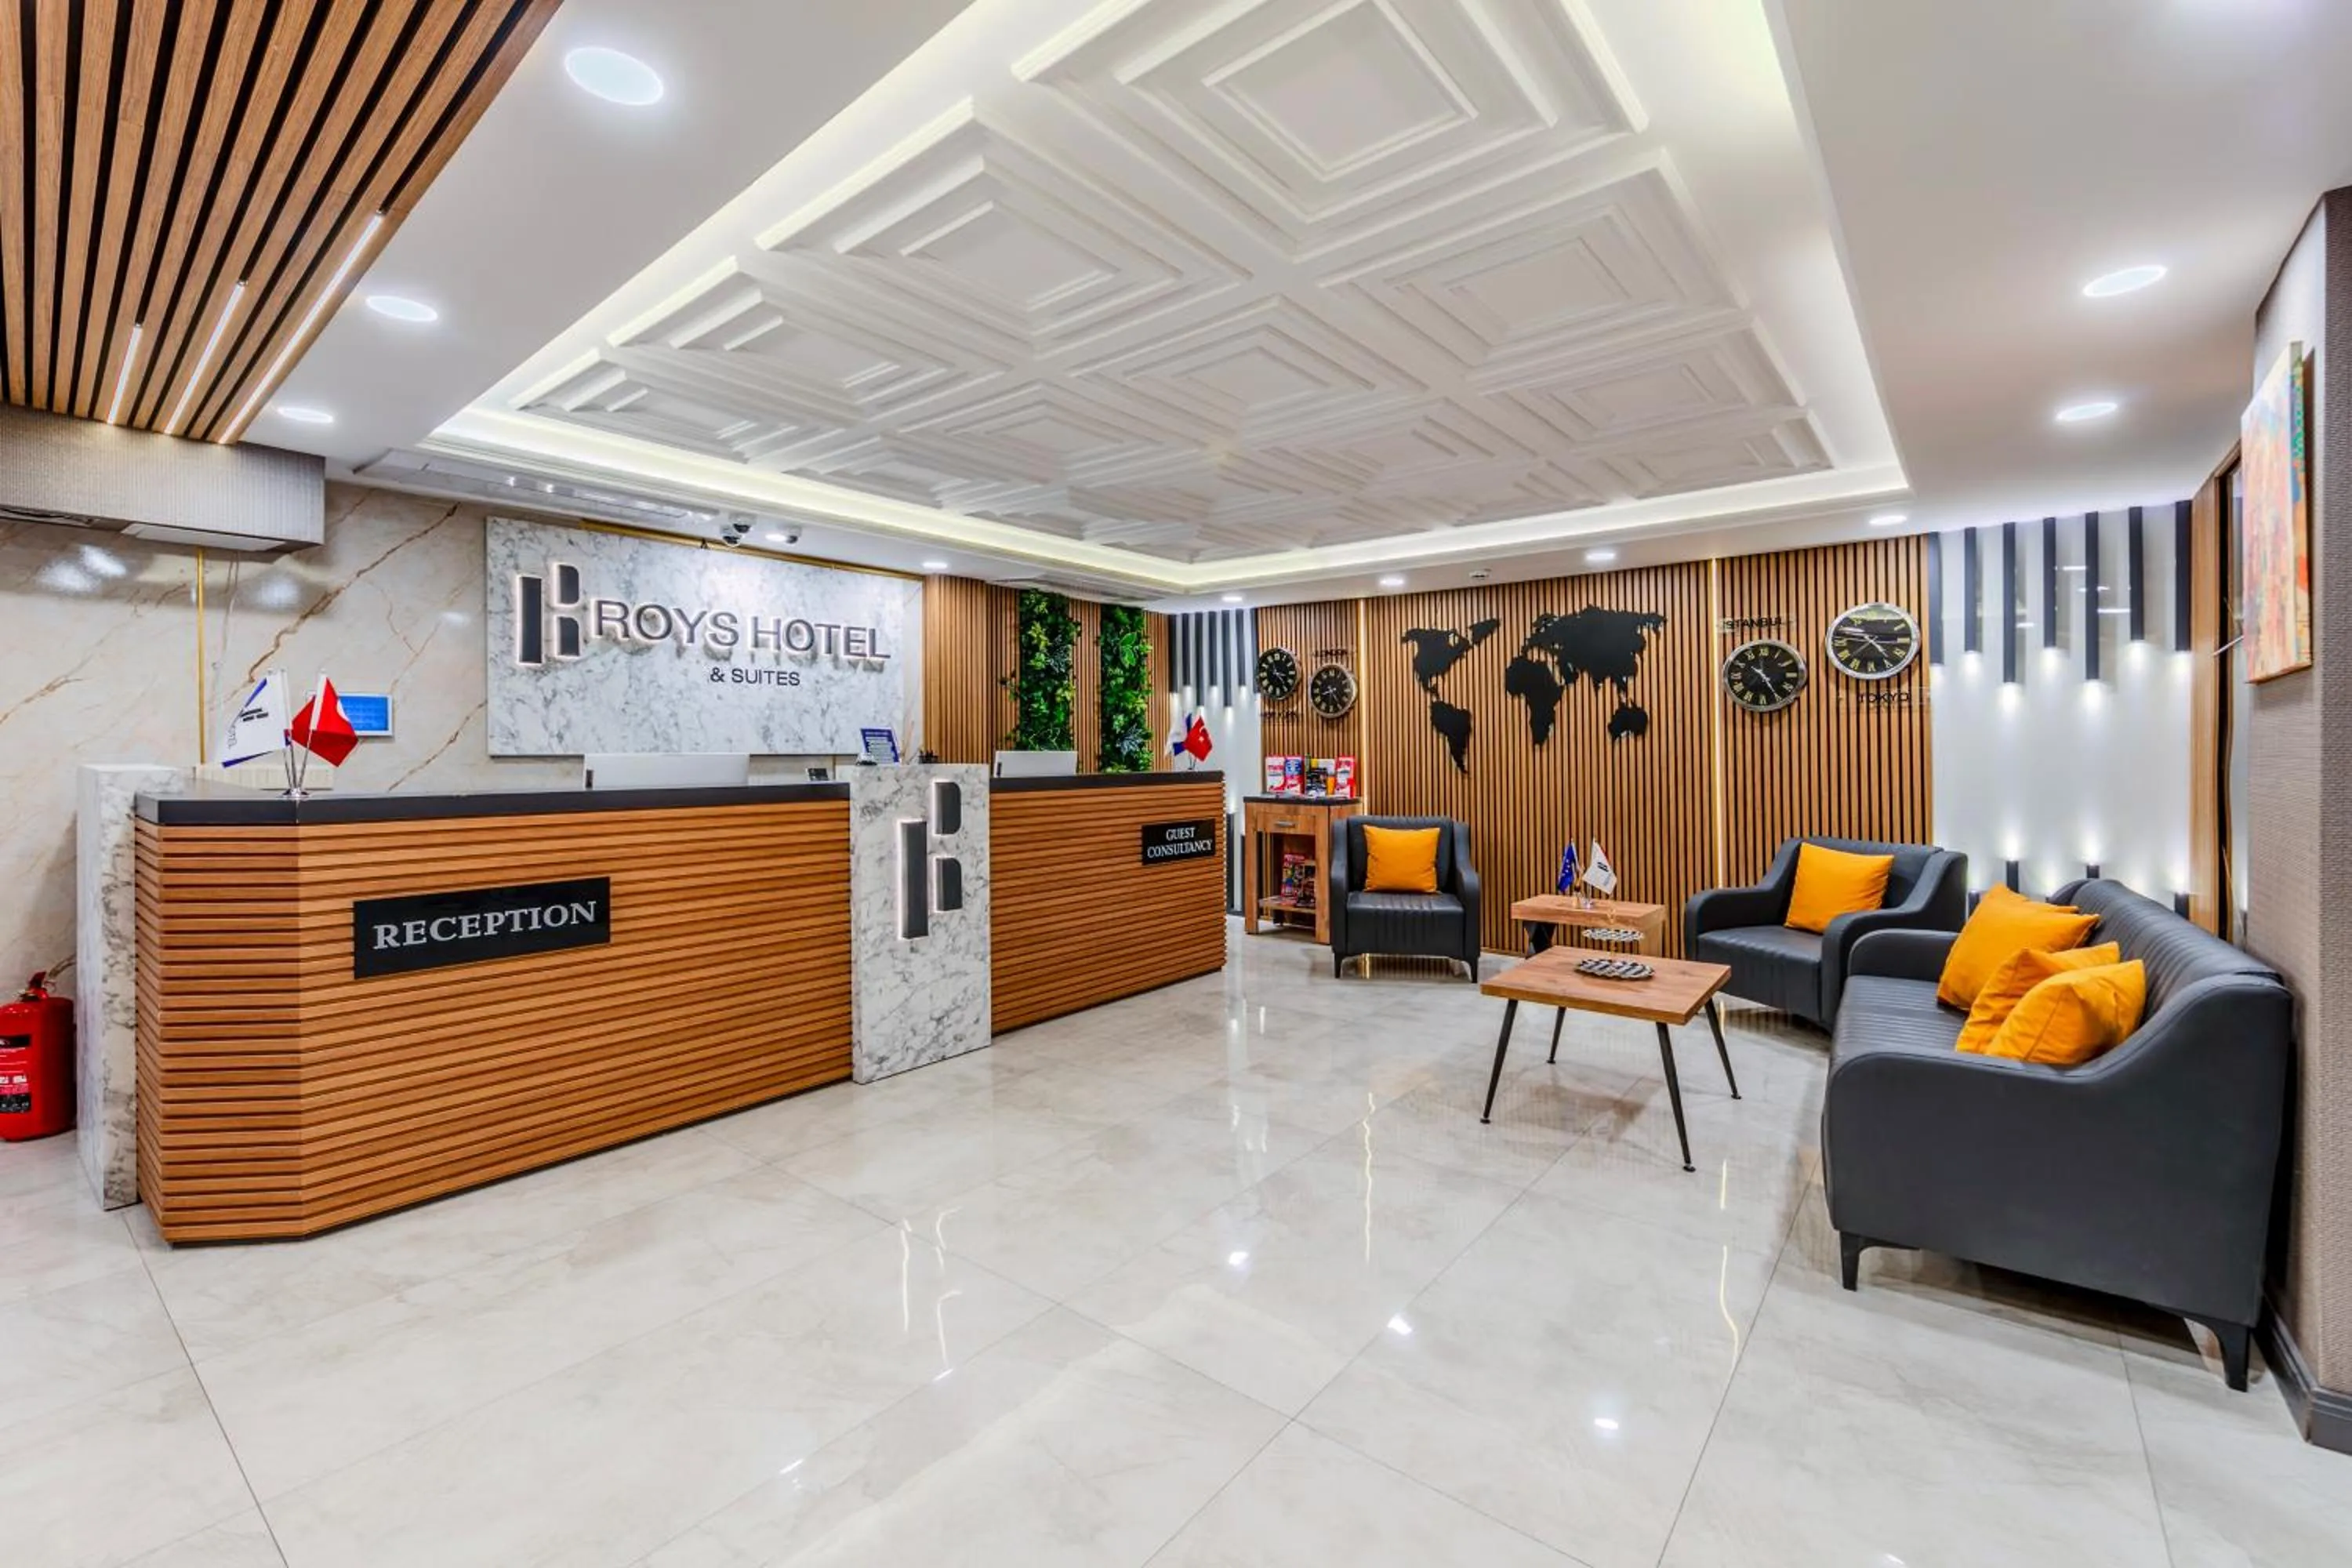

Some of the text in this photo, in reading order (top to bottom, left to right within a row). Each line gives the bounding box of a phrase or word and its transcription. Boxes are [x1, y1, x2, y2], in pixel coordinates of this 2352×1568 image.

[594, 600, 891, 659] ROYS HOTEL
[710, 667, 801, 686] & SUITES
[1165, 826, 1196, 841] GUEST
[1146, 839, 1213, 858] CONSULTANCY
[372, 901, 597, 950] RECEPTION
